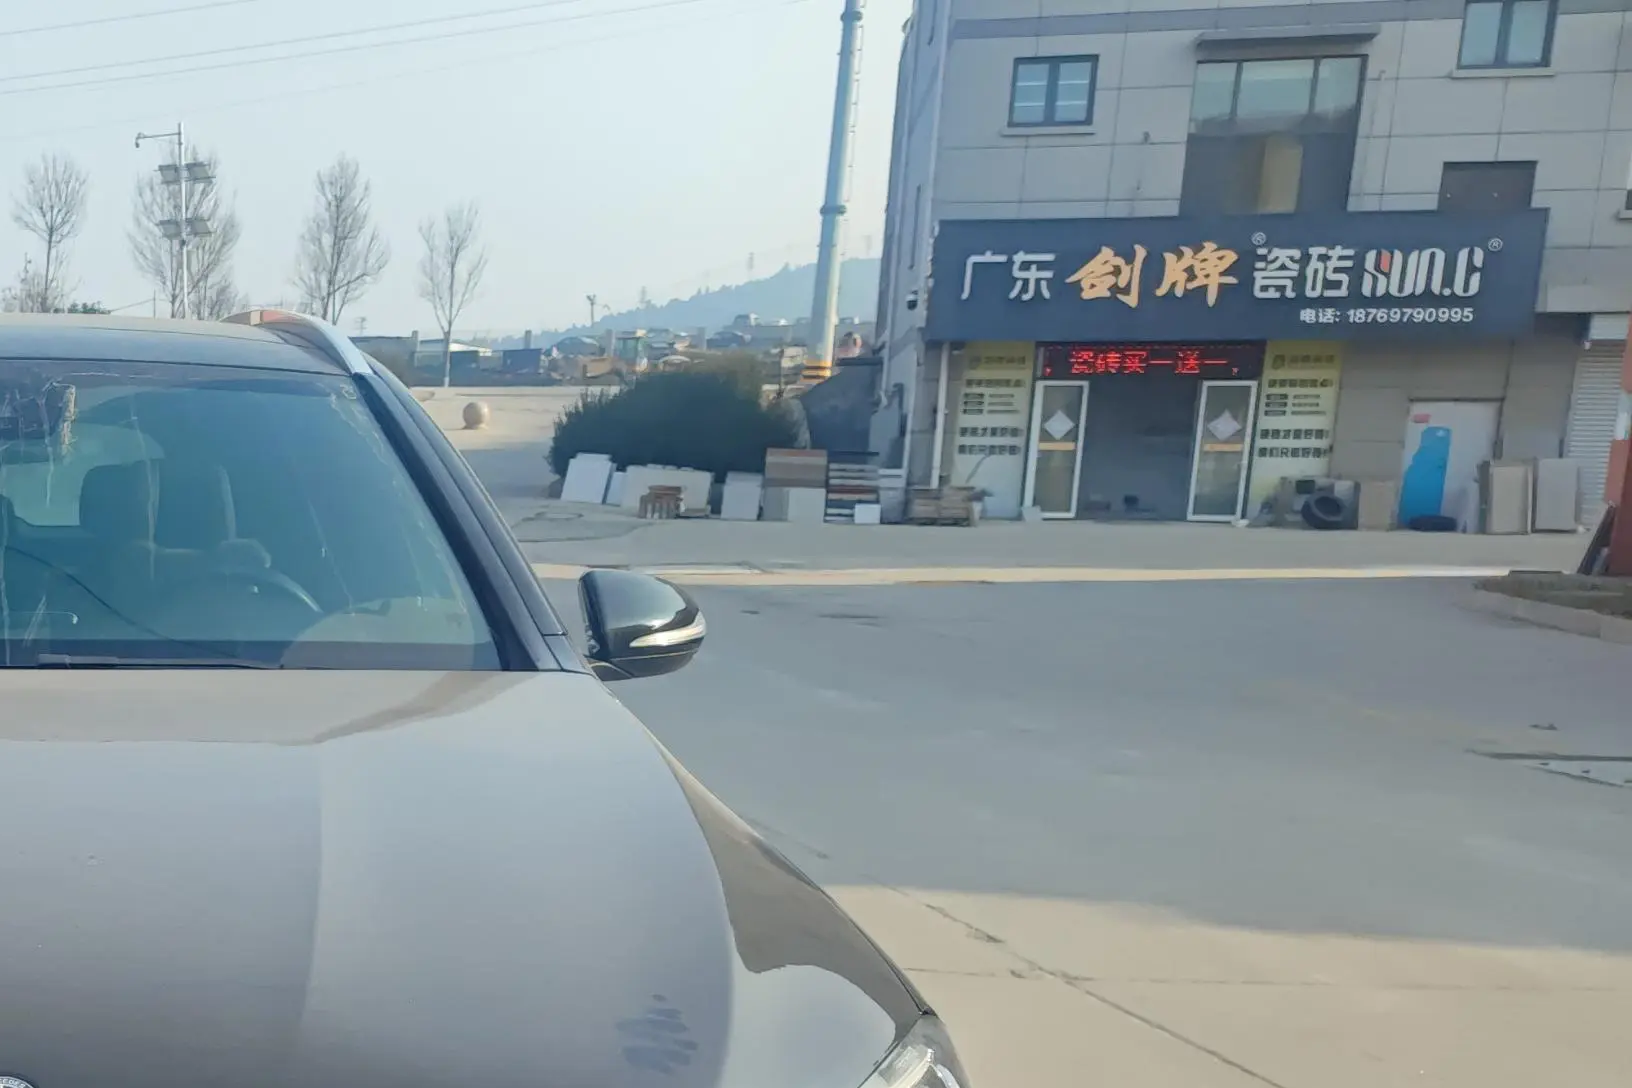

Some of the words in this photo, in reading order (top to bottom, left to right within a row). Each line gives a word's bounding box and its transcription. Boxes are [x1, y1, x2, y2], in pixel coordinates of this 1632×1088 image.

[961, 250, 1057, 301] 广东
[1252, 245, 1355, 299] 瓷砖
[1347, 307, 1474, 323] 18769790995
[1069, 350, 1229, 375] 瓷砖买一送一
